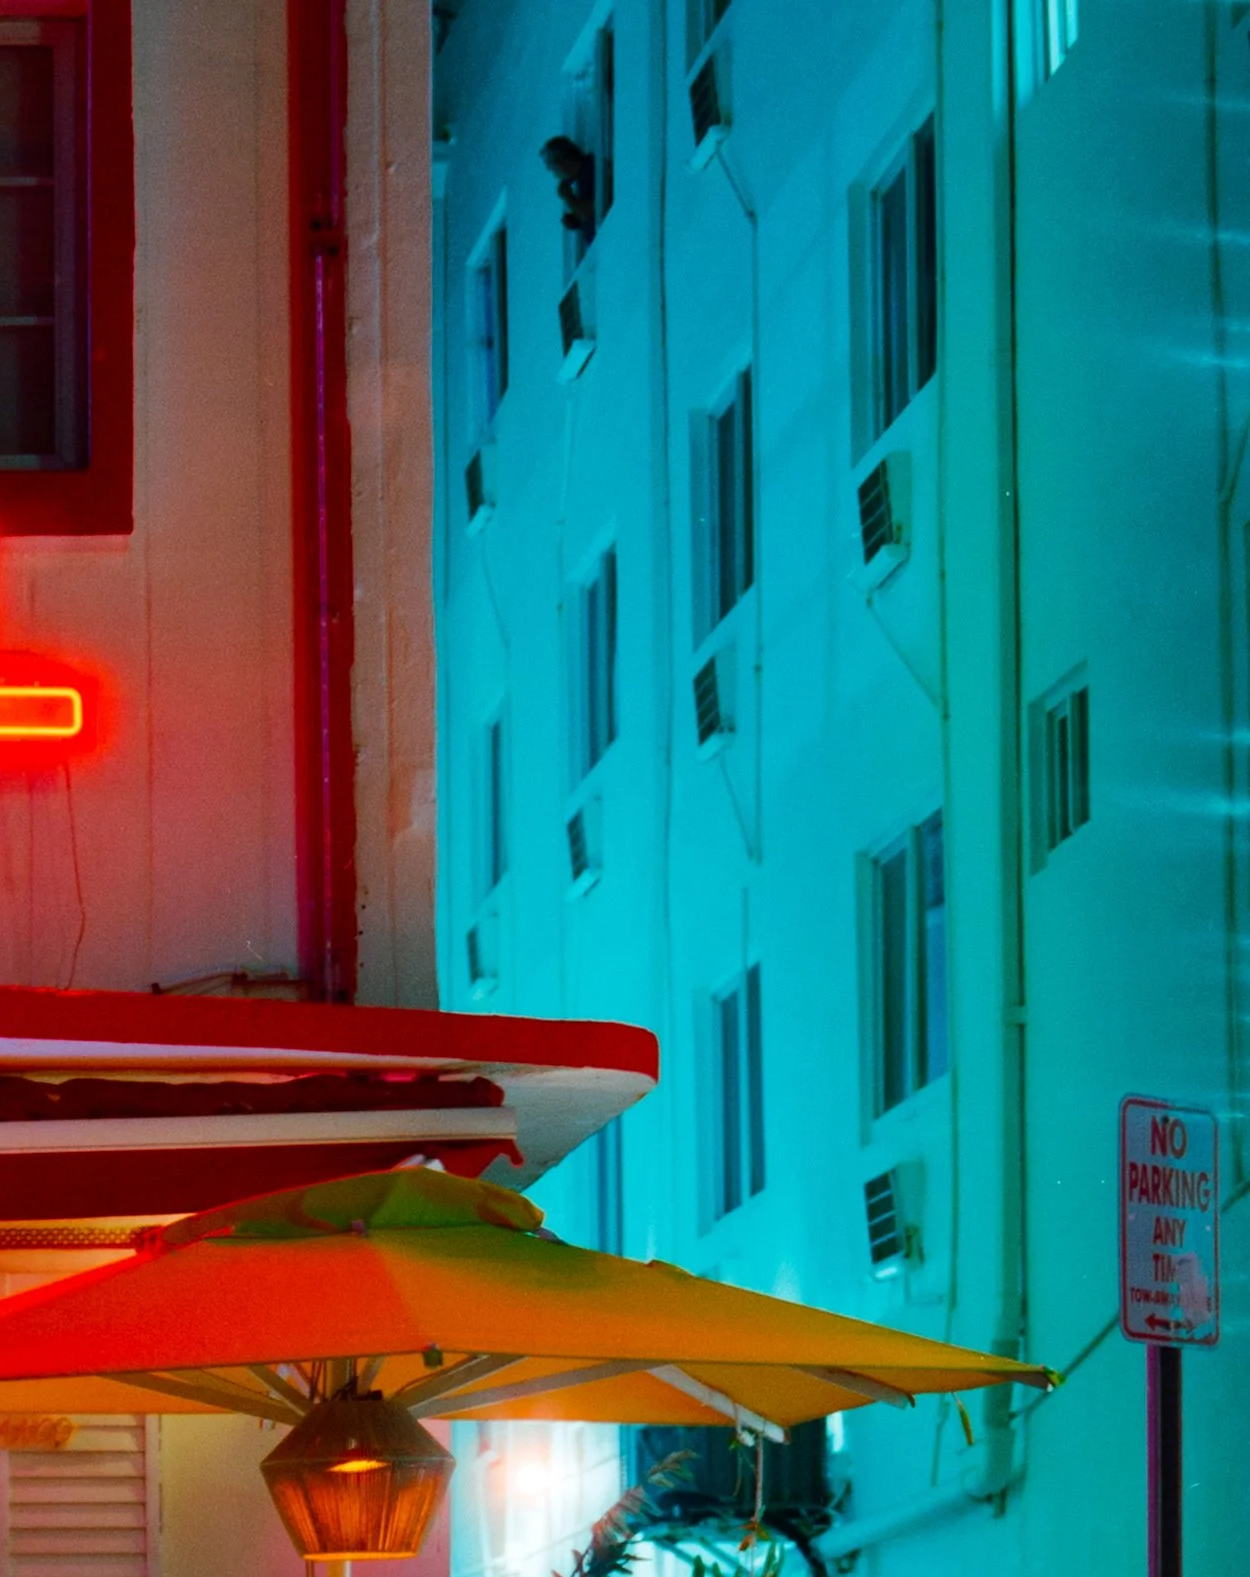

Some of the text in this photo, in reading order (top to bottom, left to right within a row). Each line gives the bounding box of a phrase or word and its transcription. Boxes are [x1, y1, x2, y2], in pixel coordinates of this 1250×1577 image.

[1151, 1116, 1187, 1159] NO
[1129, 1162, 1210, 1213] PARKING
[1153, 1216, 1186, 1248] ANY
[1152, 1253, 1178, 1286] TIM
